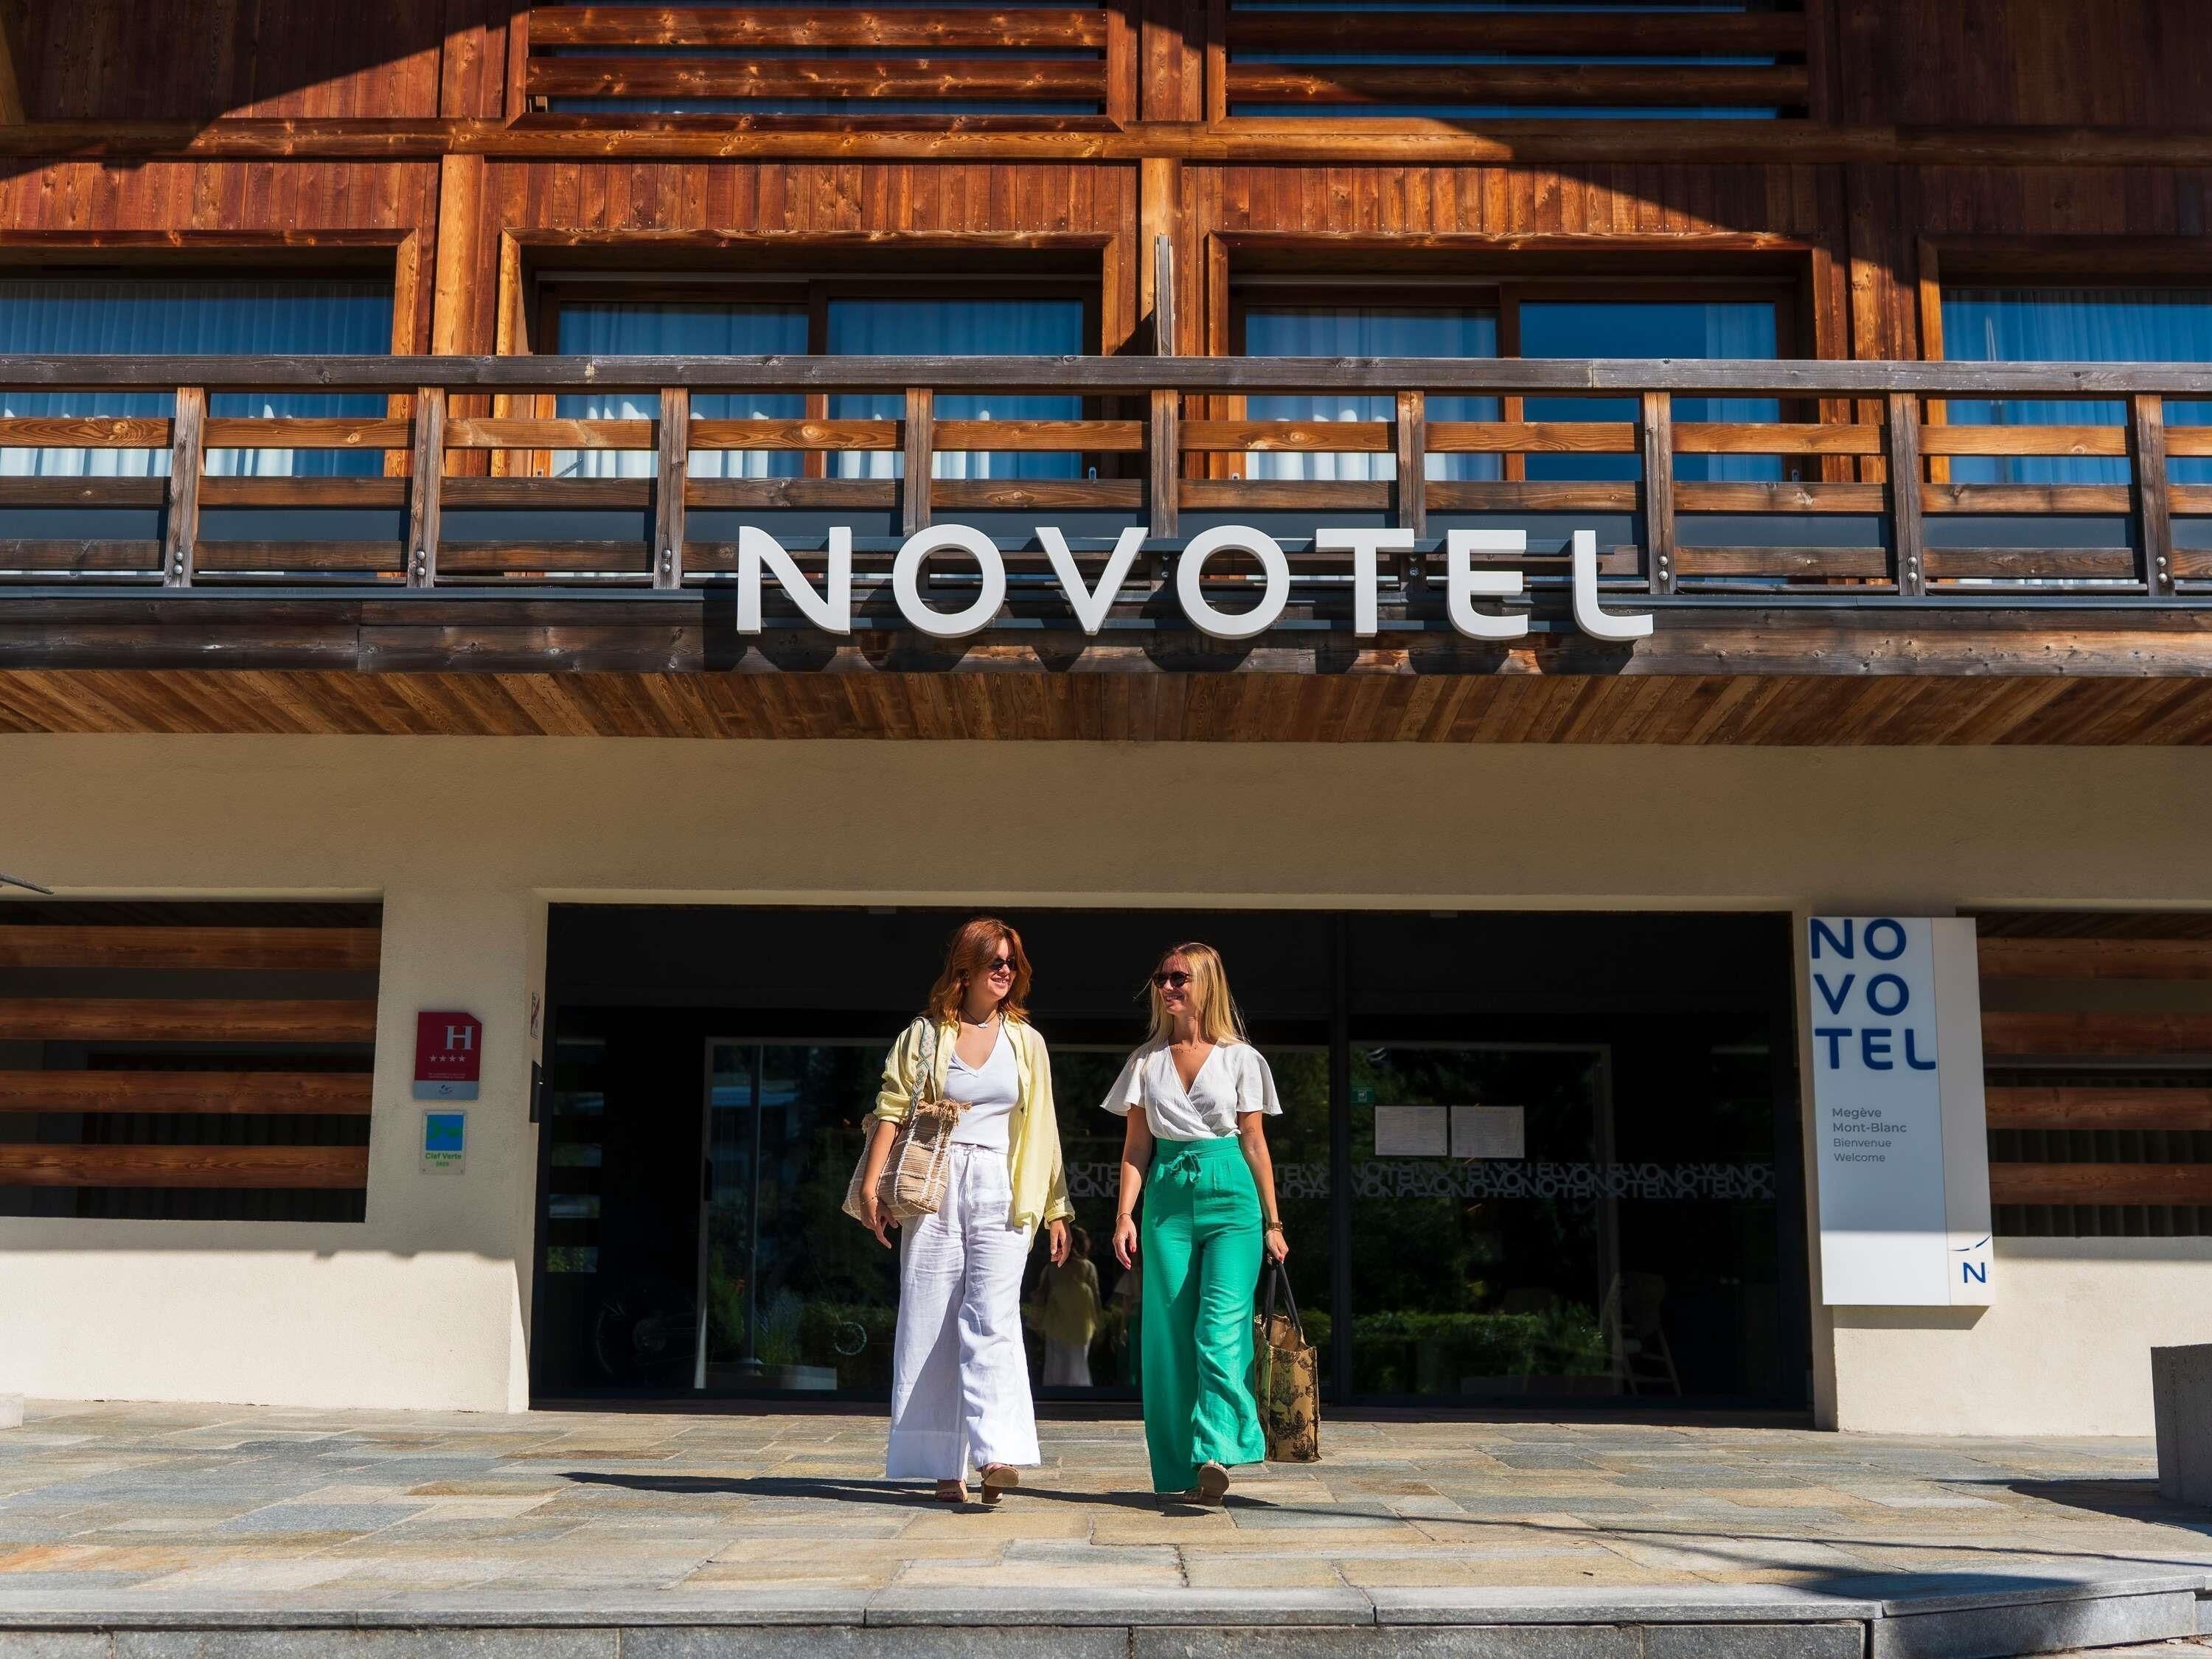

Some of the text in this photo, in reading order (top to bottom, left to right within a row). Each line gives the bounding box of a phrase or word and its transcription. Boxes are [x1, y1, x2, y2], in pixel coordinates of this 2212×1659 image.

[737, 524, 1654, 642] NOVOTEL
[1810, 919, 1907, 960] NO
[1813, 973, 1910, 1016] VO
[445, 1026, 473, 1050] H
[1815, 1029, 1936, 1070] TEL
[1832, 1107, 1882, 1119] Megève
[1832, 1122, 1907, 1133] Mont-Blanc
[1833, 1138, 1892, 1147] Bienvenue
[1834, 1152, 1886, 1162] Welcome
[1962, 1262, 1986, 1283] N
